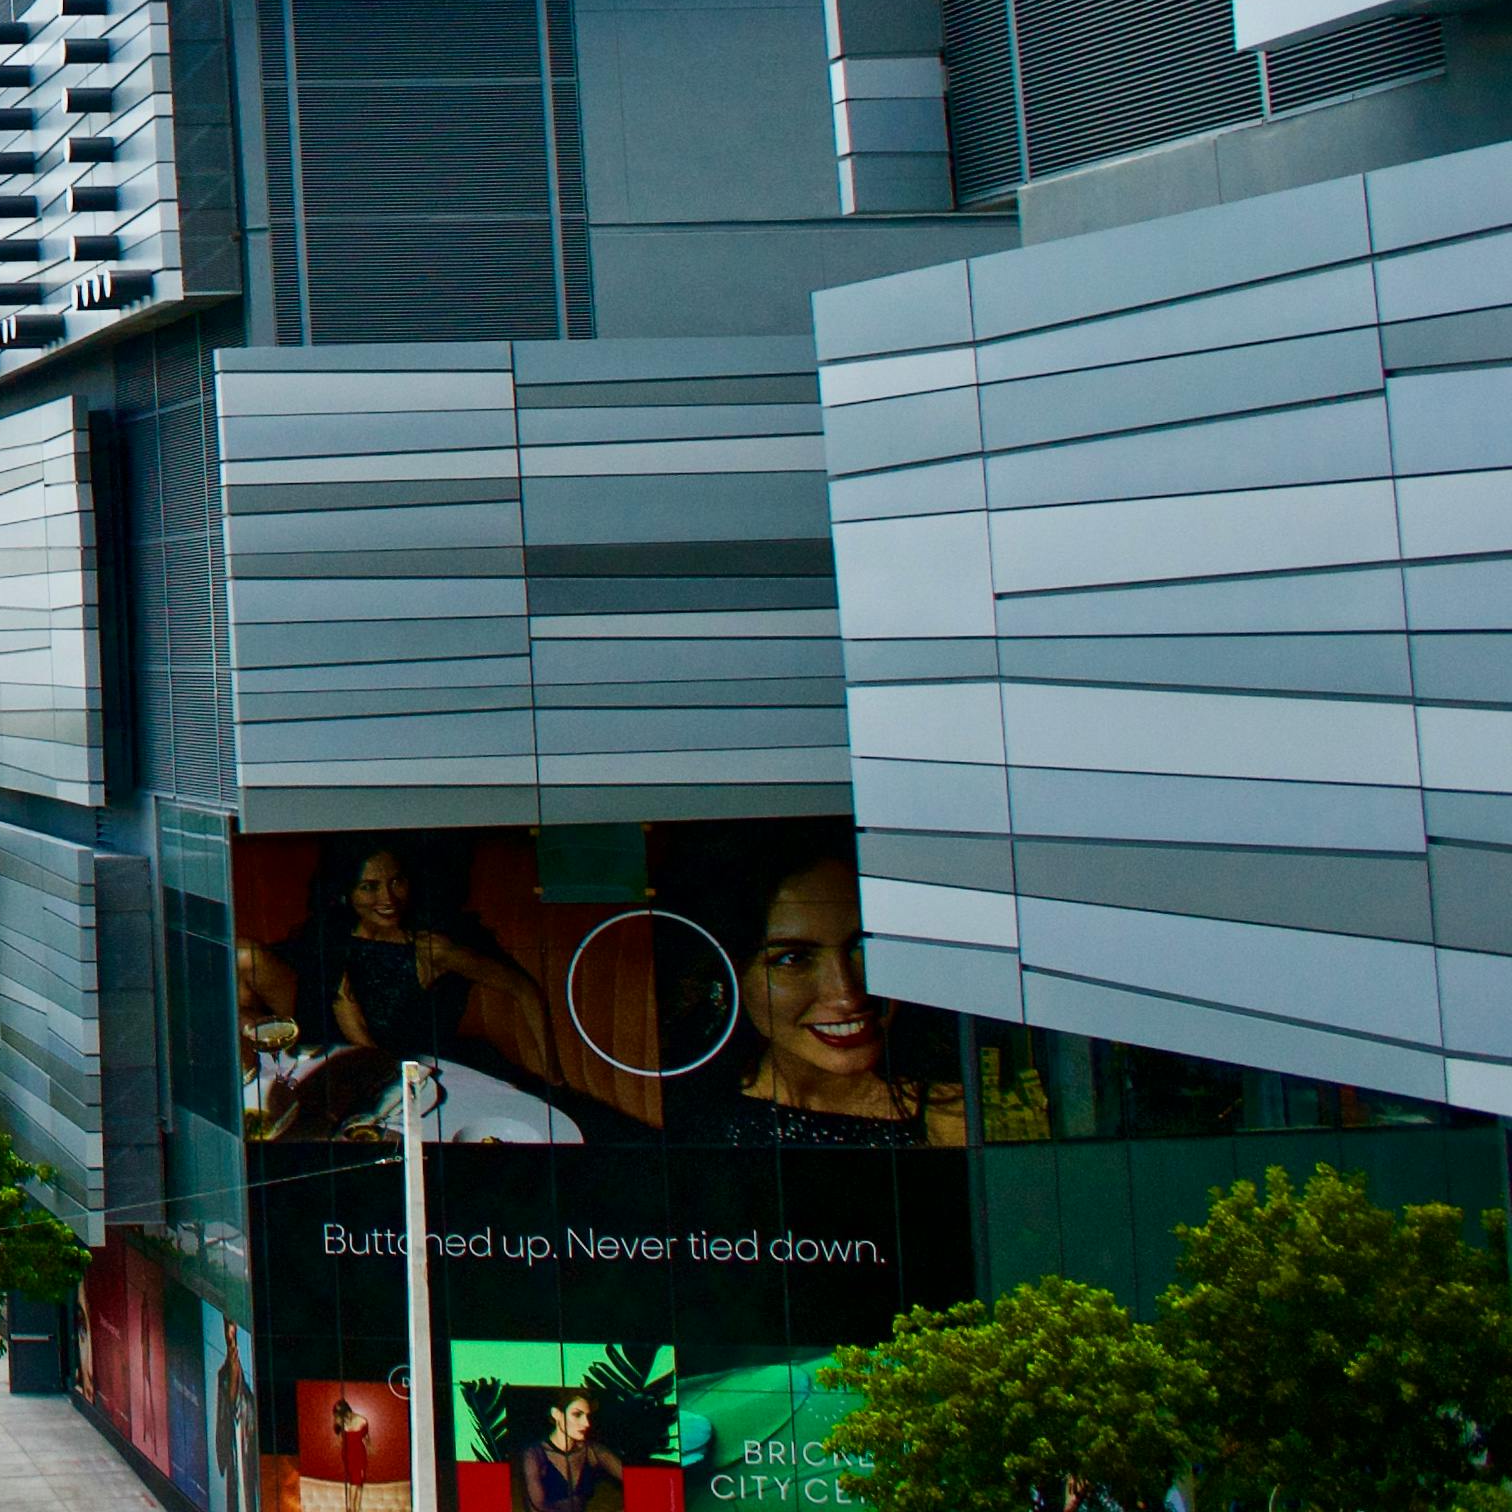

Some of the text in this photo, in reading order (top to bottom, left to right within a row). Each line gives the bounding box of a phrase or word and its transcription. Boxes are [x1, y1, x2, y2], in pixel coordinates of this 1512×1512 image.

[502, 1235, 558, 1266] up.
[567, 1227, 678, 1259] Never
[687, 1229, 759, 1261] tied
[769, 1229, 887, 1263] down.
[710, 1473, 791, 1501] CITY
